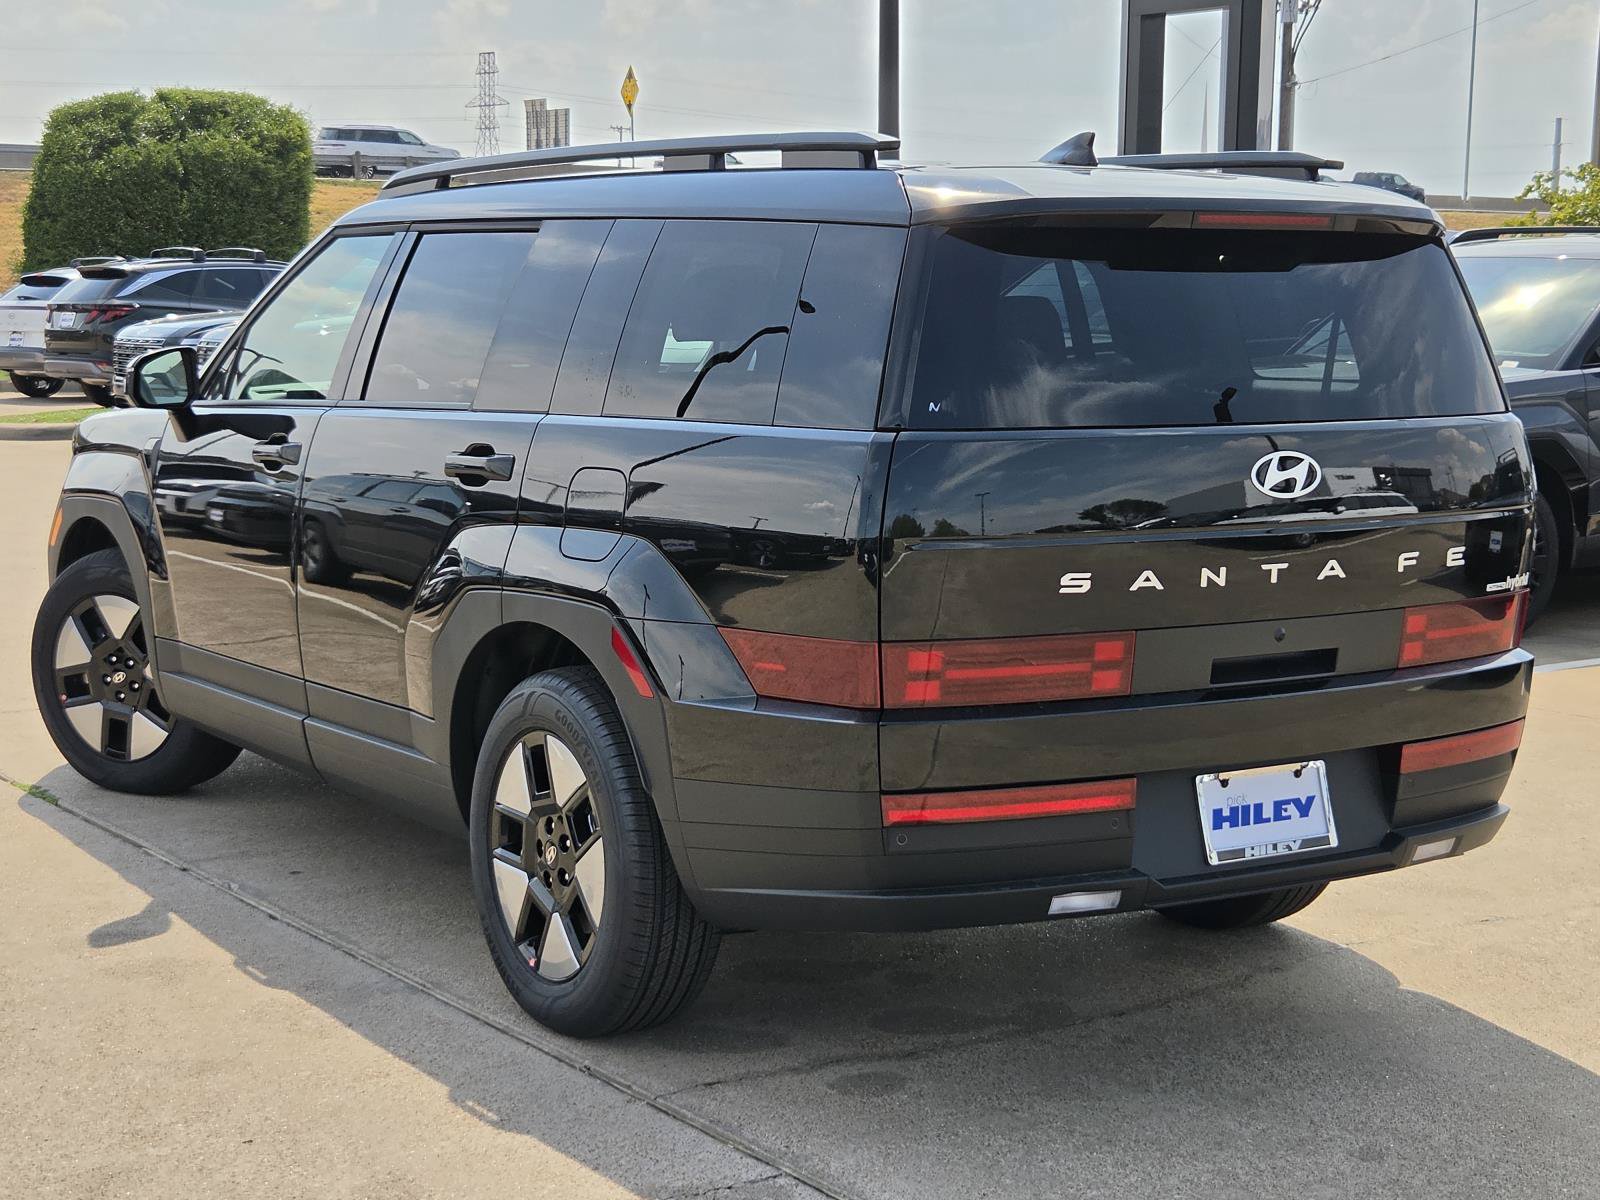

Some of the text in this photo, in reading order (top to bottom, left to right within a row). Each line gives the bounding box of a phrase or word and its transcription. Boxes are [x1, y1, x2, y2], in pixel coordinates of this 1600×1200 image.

[1059, 546, 1466, 593] SANTA FE
[1212, 795, 1316, 831] HILEY
[1244, 839, 1302, 858] HILEY
